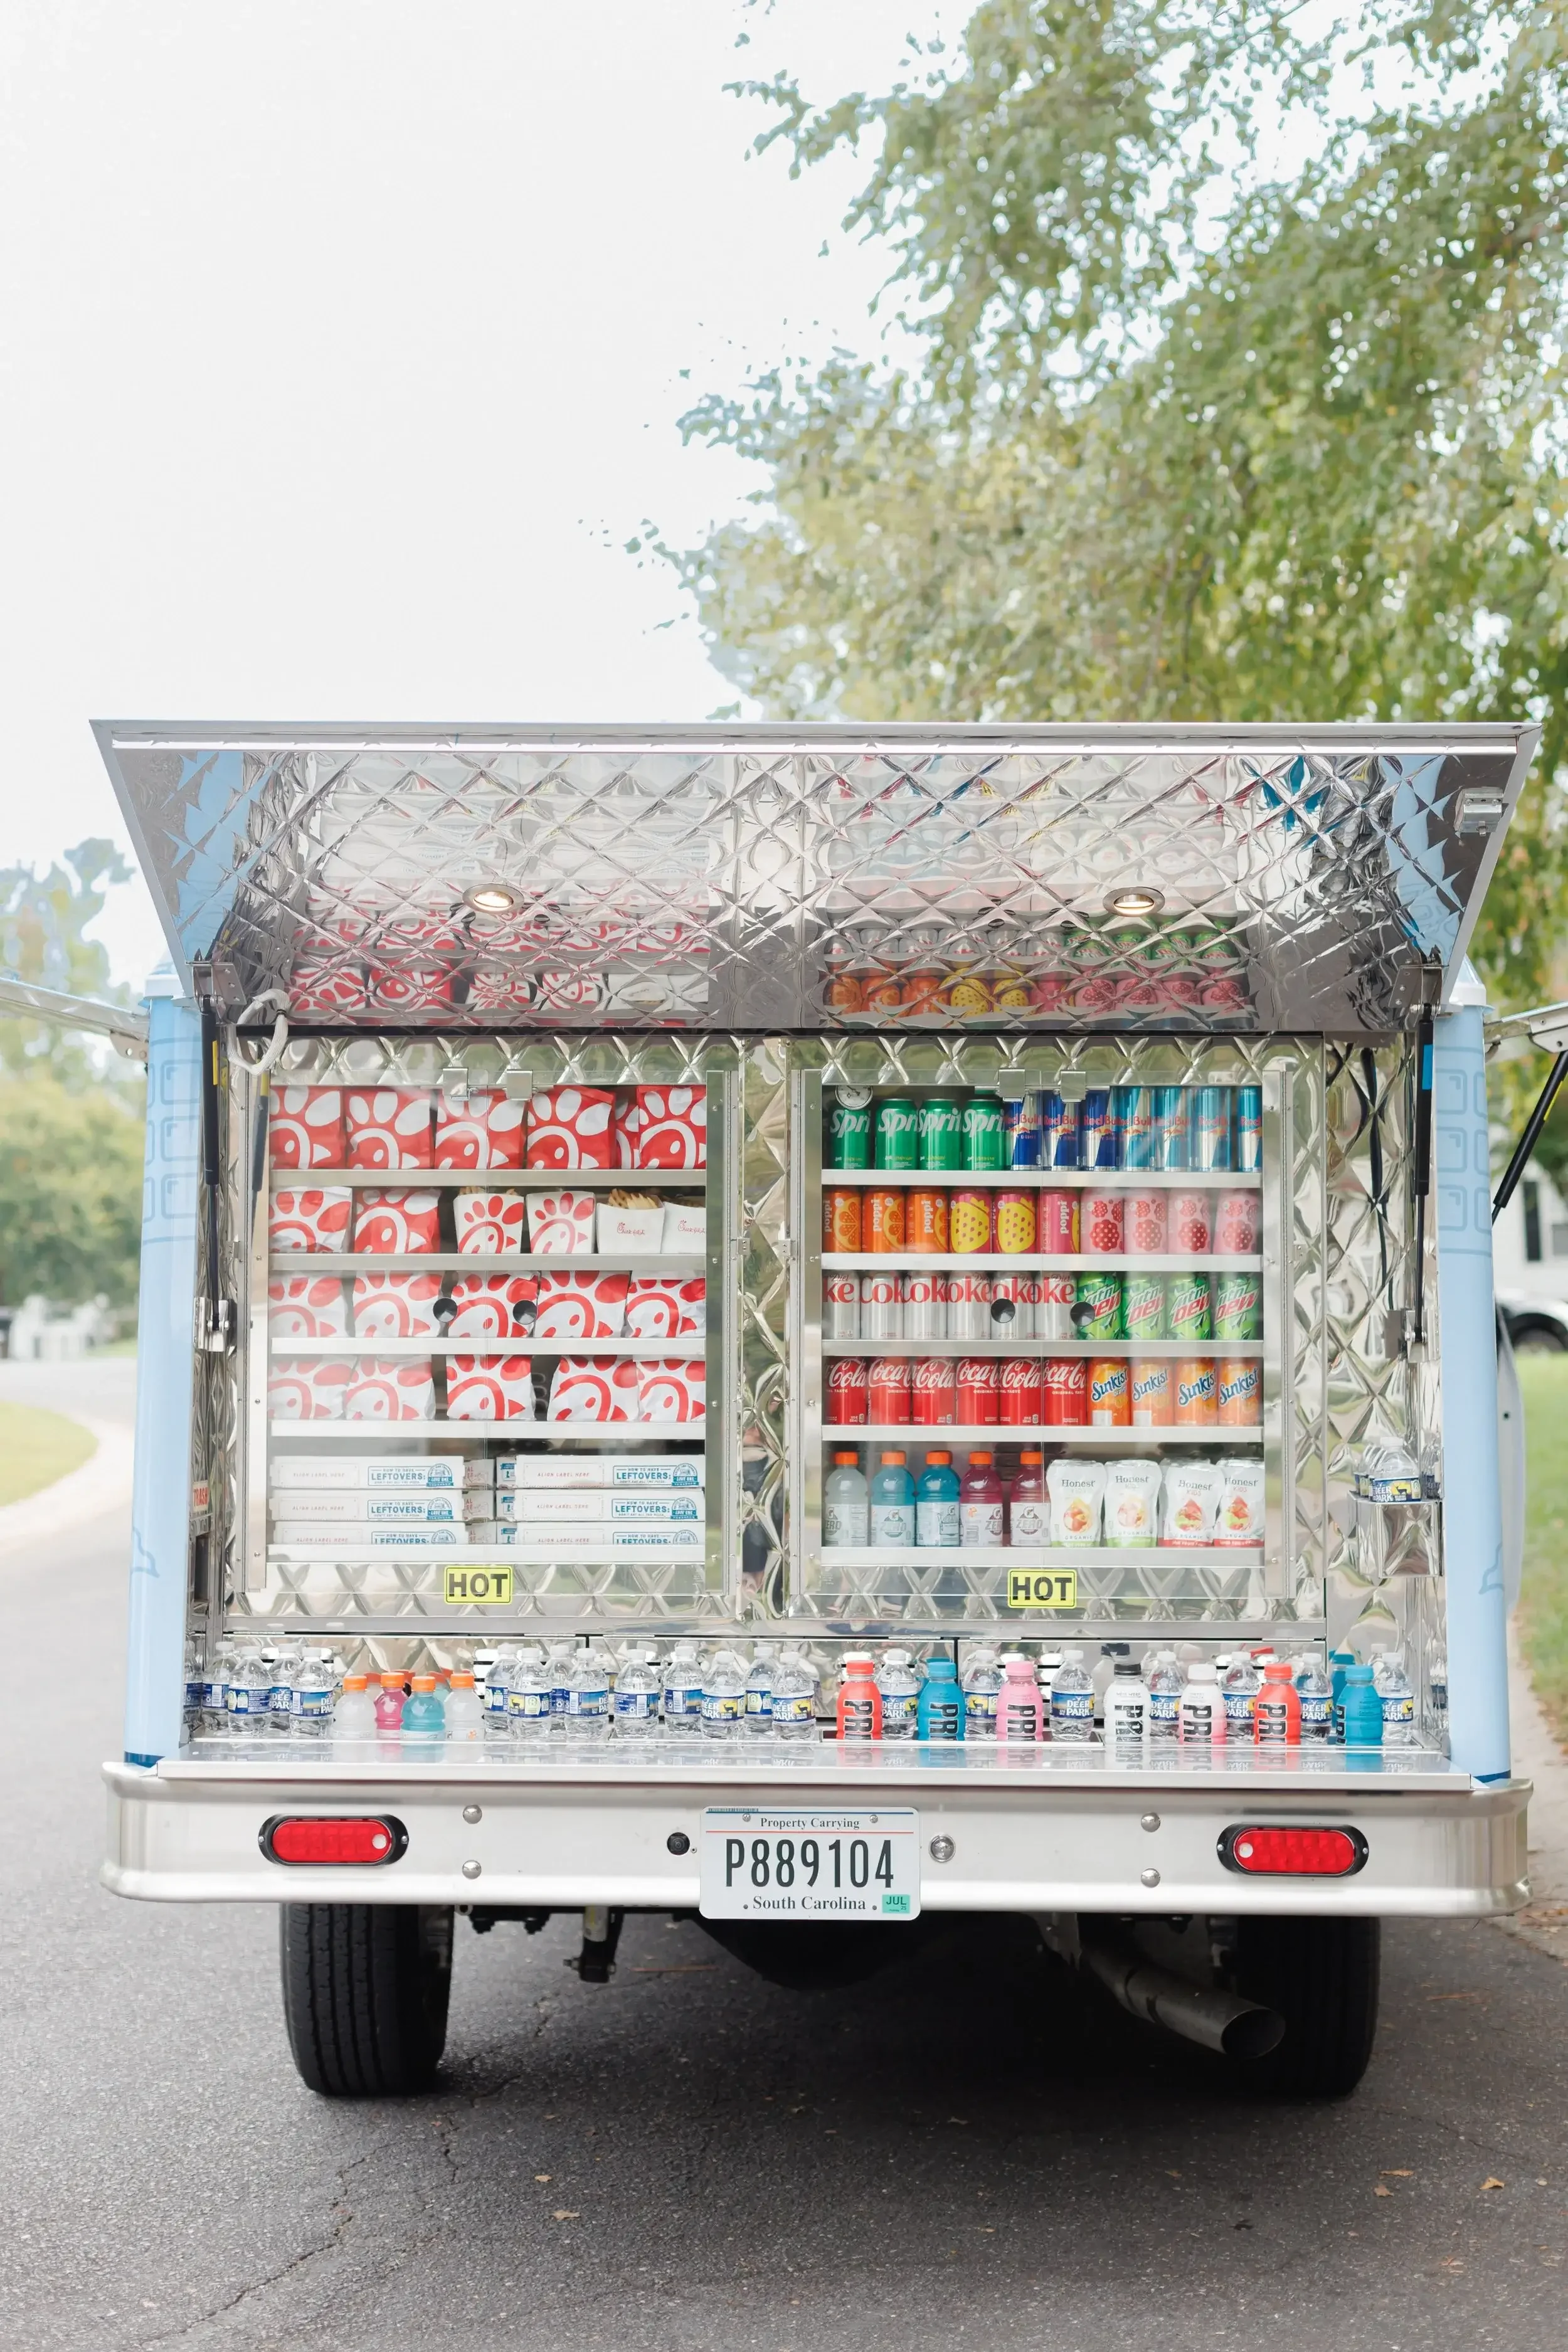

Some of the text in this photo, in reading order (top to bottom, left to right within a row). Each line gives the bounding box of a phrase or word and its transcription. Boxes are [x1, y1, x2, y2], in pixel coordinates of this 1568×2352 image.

[1084, 1114, 1103, 1125] Red
[824, 1200, 832, 1232] poppi
[871, 1199, 882, 1232] poppi
[921, 1199, 933, 1234] poppi
[1057, 1200, 1069, 1234] poppi
[1091, 1367, 1127, 1401] Sunkist
[1132, 1367, 1168, 1402] Sunkist
[1178, 1368, 1216, 1406] Sunkist
[1219, 1367, 1258, 1406] Sunkist
[1061, 1479, 1096, 1487] Honest
[1178, 1479, 1213, 1491] Honest
[1224, 1478, 1259, 1487] Honest
[194, 1487, 209, 1507] TRASH
[1015, 1520, 1043, 1529] ZERO
[449, 1573, 508, 1597] HOT
[1013, 1577, 1072, 1601] HOT
[1067, 1700, 1090, 1708] DEER
[1303, 1703, 1325, 1712] DEER
[881, 1709, 906, 1719] PARK
[1067, 1708, 1089, 1717] PARK
[1151, 1709, 1175, 1719] PARK
[1226, 1708, 1249, 1718] PARK
[1303, 1712, 1326, 1720] PARK
[760, 1818, 860, 1830] Property Carrying
[726, 1838, 894, 1888] P889104
[753, 1896, 866, 1910] South Carolina
[886, 1896, 907, 1905] JUL
